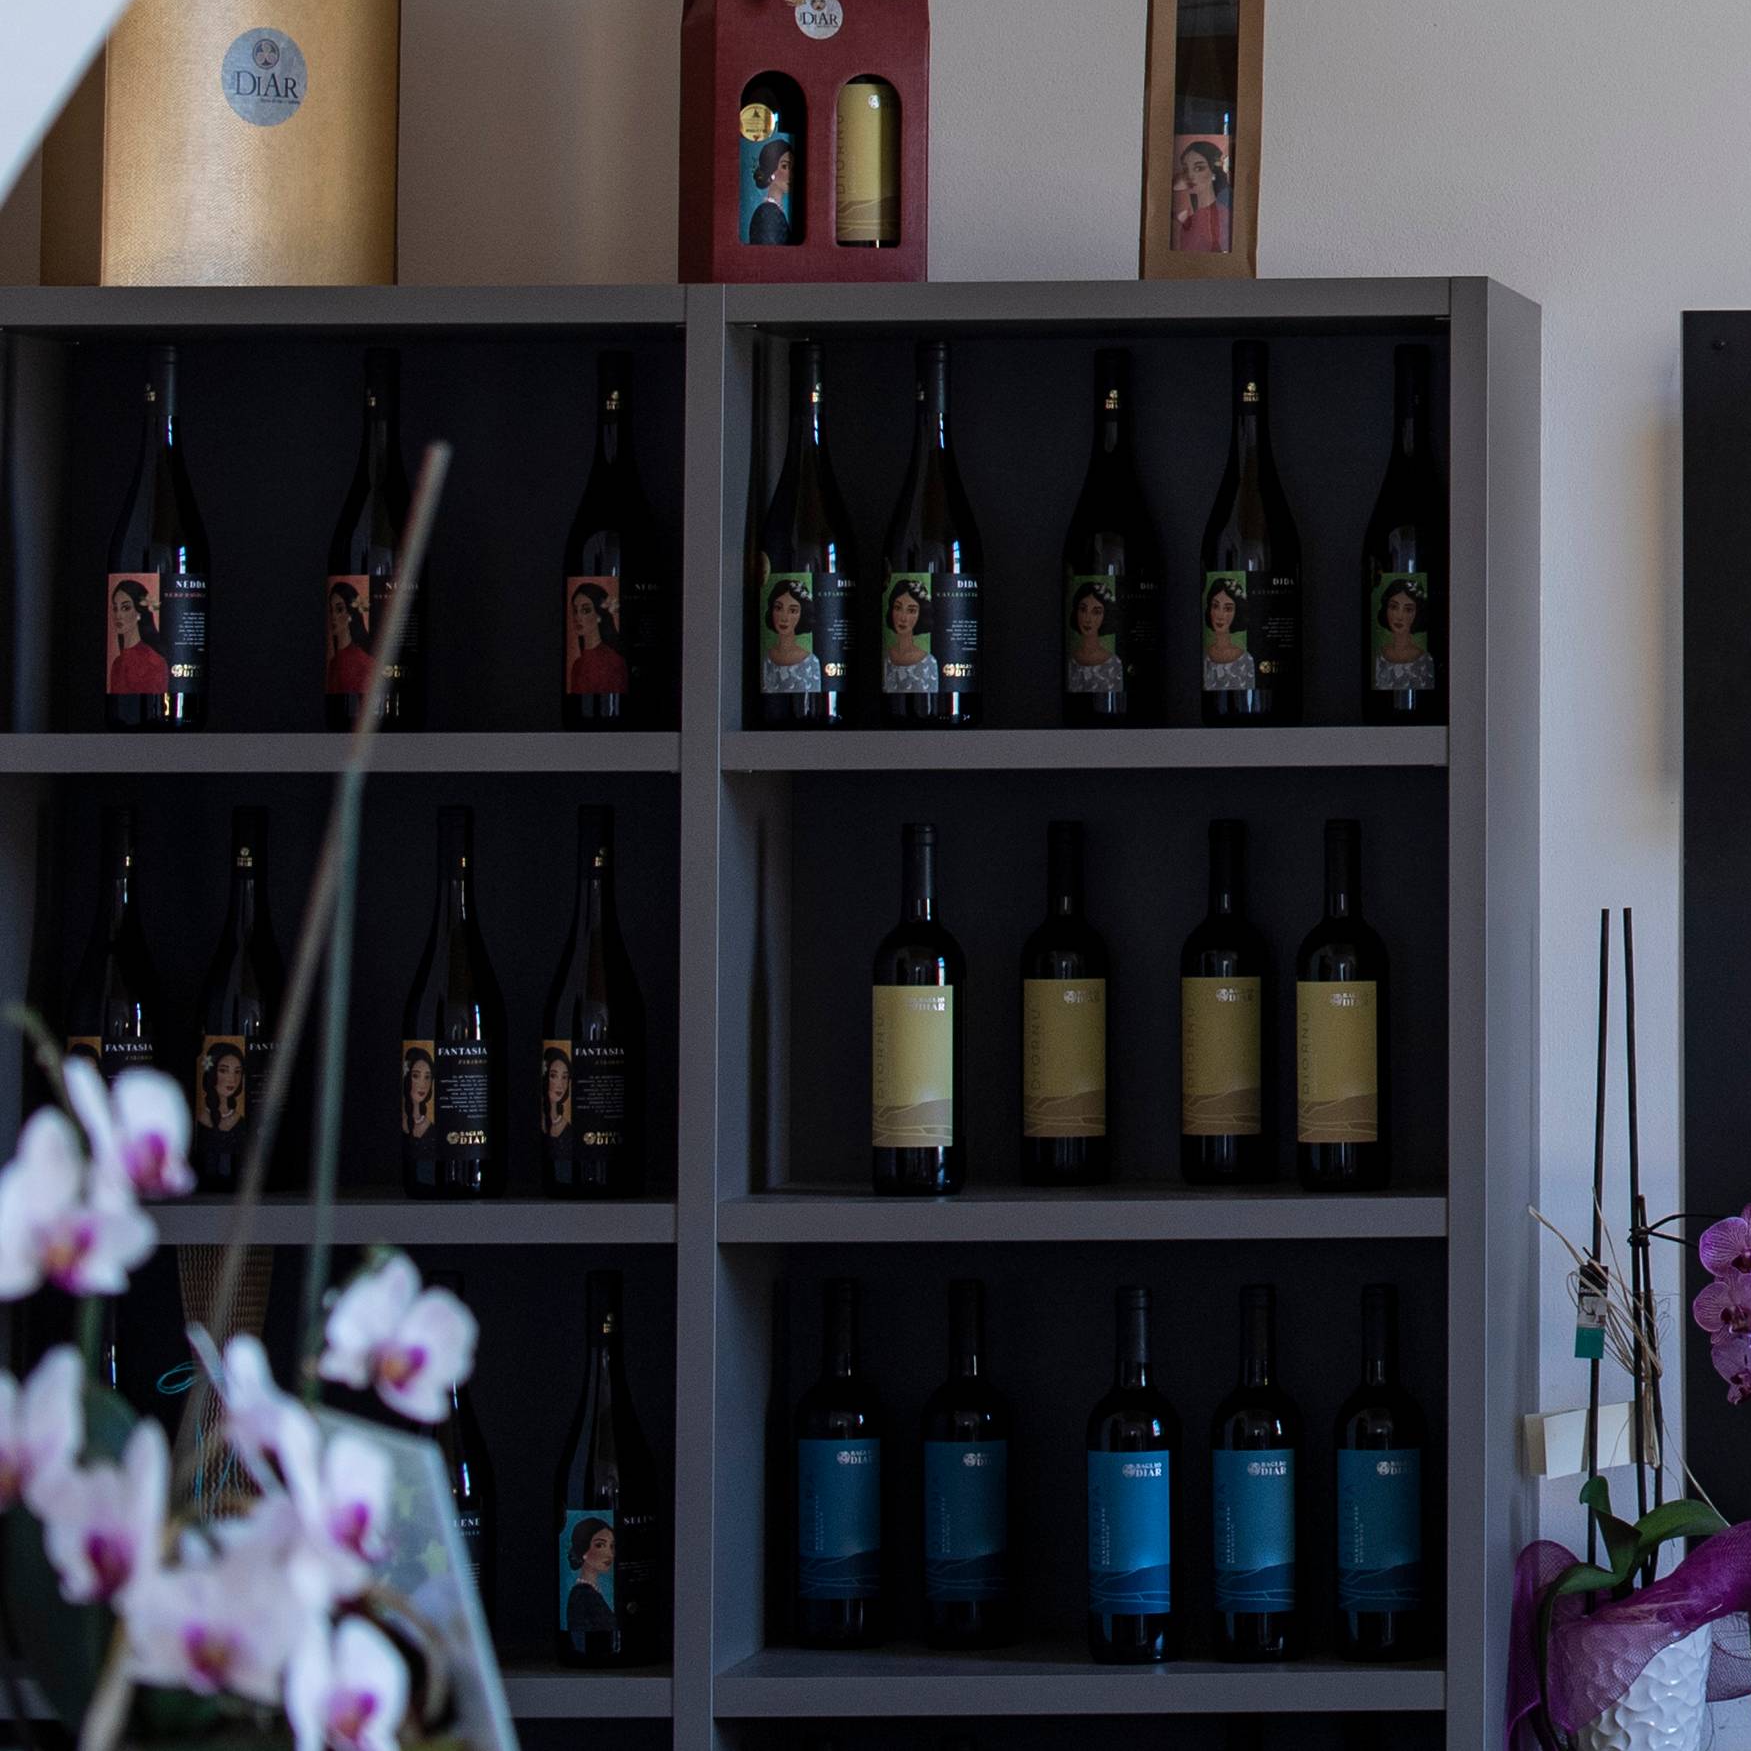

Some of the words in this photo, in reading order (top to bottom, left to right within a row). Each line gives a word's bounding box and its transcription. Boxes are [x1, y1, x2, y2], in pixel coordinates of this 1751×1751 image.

[105, 1043, 153, 1052] FANTASIA
[438, 1047, 488, 1056] FANTASIA
[575, 1047, 625, 1056] FANTASIA
[1135, 1467, 1162, 1477] DIAR
